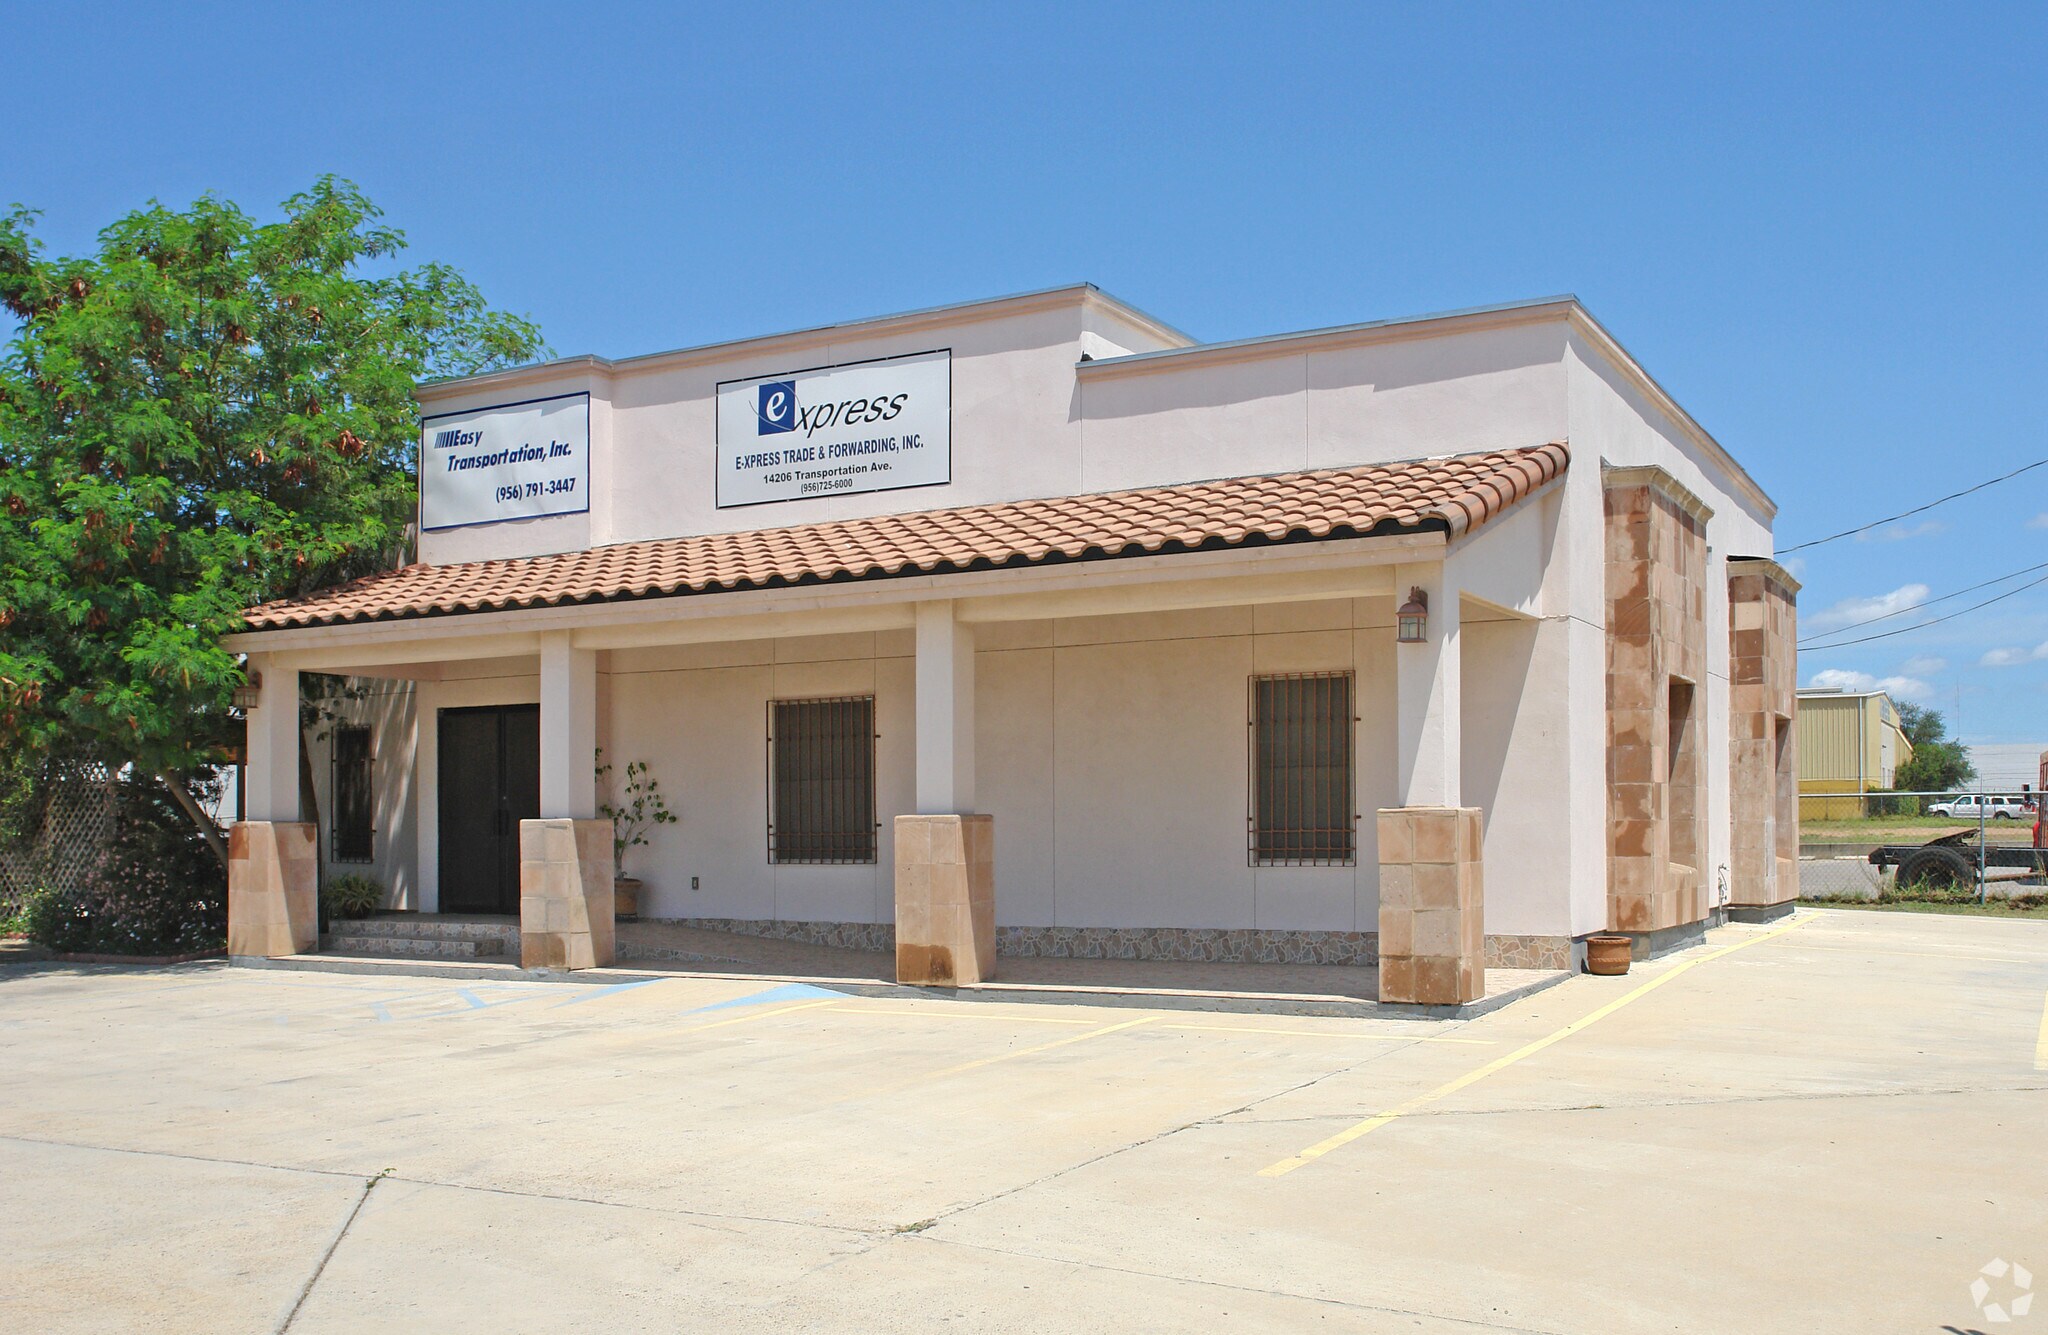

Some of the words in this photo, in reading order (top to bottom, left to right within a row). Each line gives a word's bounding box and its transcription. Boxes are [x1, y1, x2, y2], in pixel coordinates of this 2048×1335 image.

[766, 391, 909, 439] express
[453, 429, 484, 448] Easy
[735, 450, 781, 470] E-XPRESS
[783, 446, 815, 465] TRADE
[818, 446, 826, 459] &
[828, 436, 899, 455] FORWARDING,
[902, 433, 924, 450] INC.
[447, 443, 548, 472] Transportation,
[549, 440, 572, 458] Inc.
[763, 471, 792, 484] 14206
[795, 463, 868, 481] Transportation
[870, 461, 892, 472] Ave.
[800, 478, 853, 494] (956)725-6000
[496, 484, 523, 504] (956)
[526, 477, 576, 497] 791-3447
